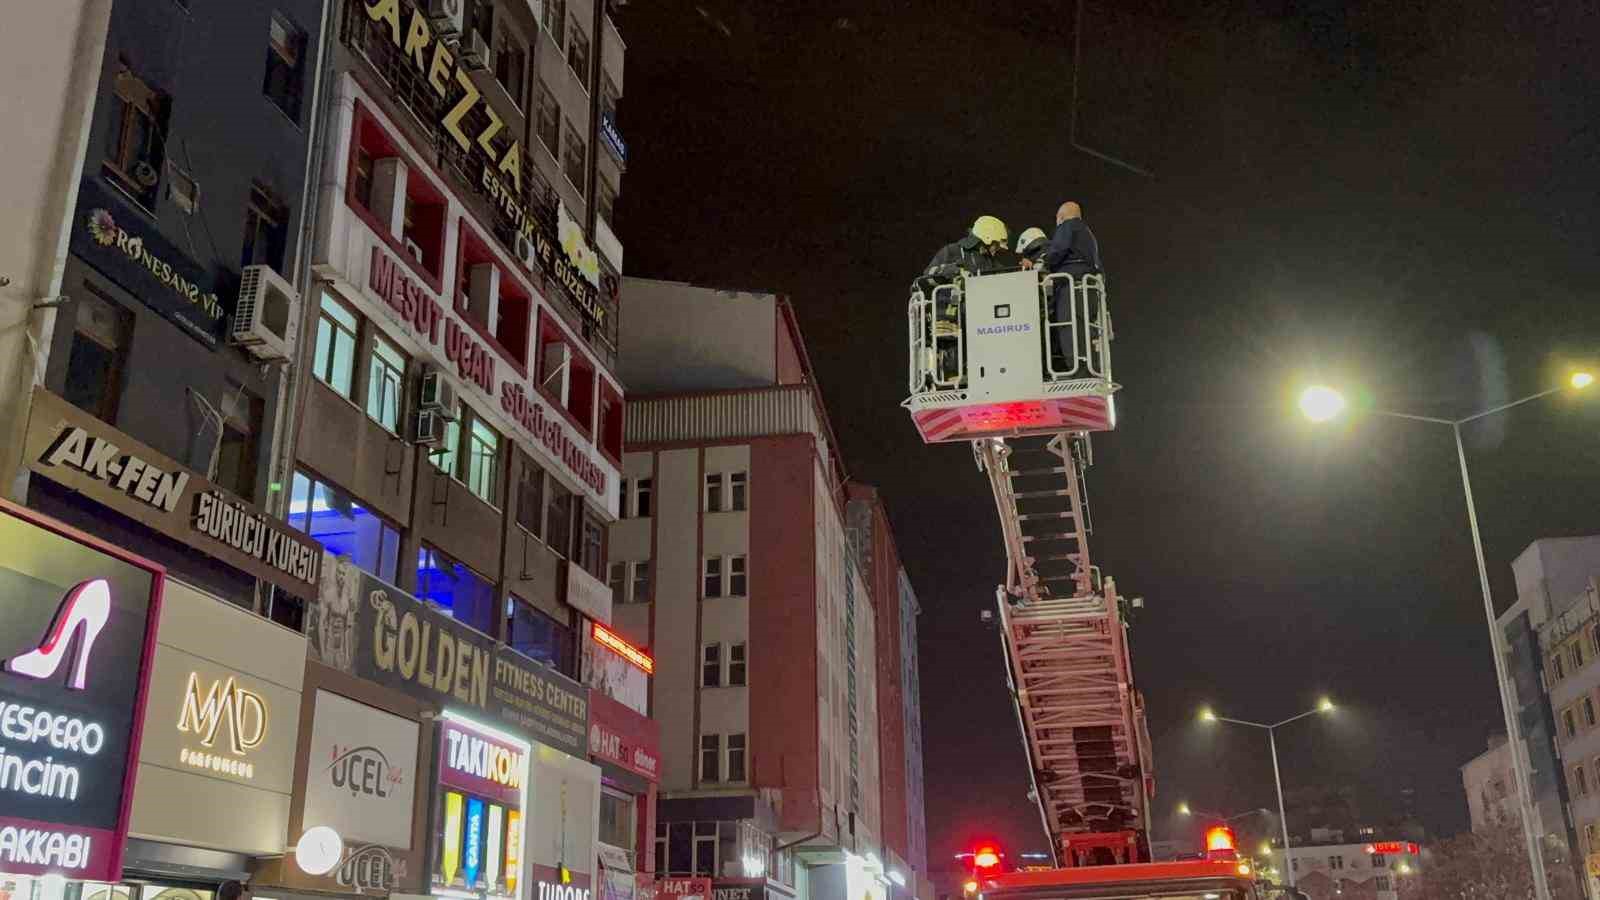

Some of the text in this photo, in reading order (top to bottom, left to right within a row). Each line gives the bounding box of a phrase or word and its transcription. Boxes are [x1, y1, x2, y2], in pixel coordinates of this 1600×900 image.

[536, 231, 551, 264] VE
[976, 323, 1032, 336] MAGIRUS
[369, 246, 606, 496] MESUT UÇAN SÜRÜCÜ KURSU
[47, 426, 319, 585] AK-FEN SÜRÜCÜ KURSU
[370, 590, 490, 709] GOLDEN
[177, 671, 268, 756] MAD
[496, 659, 544, 700] FITNESS
[546, 682, 587, 721] CENTER
[0, 826, 91, 869] AKKABI
